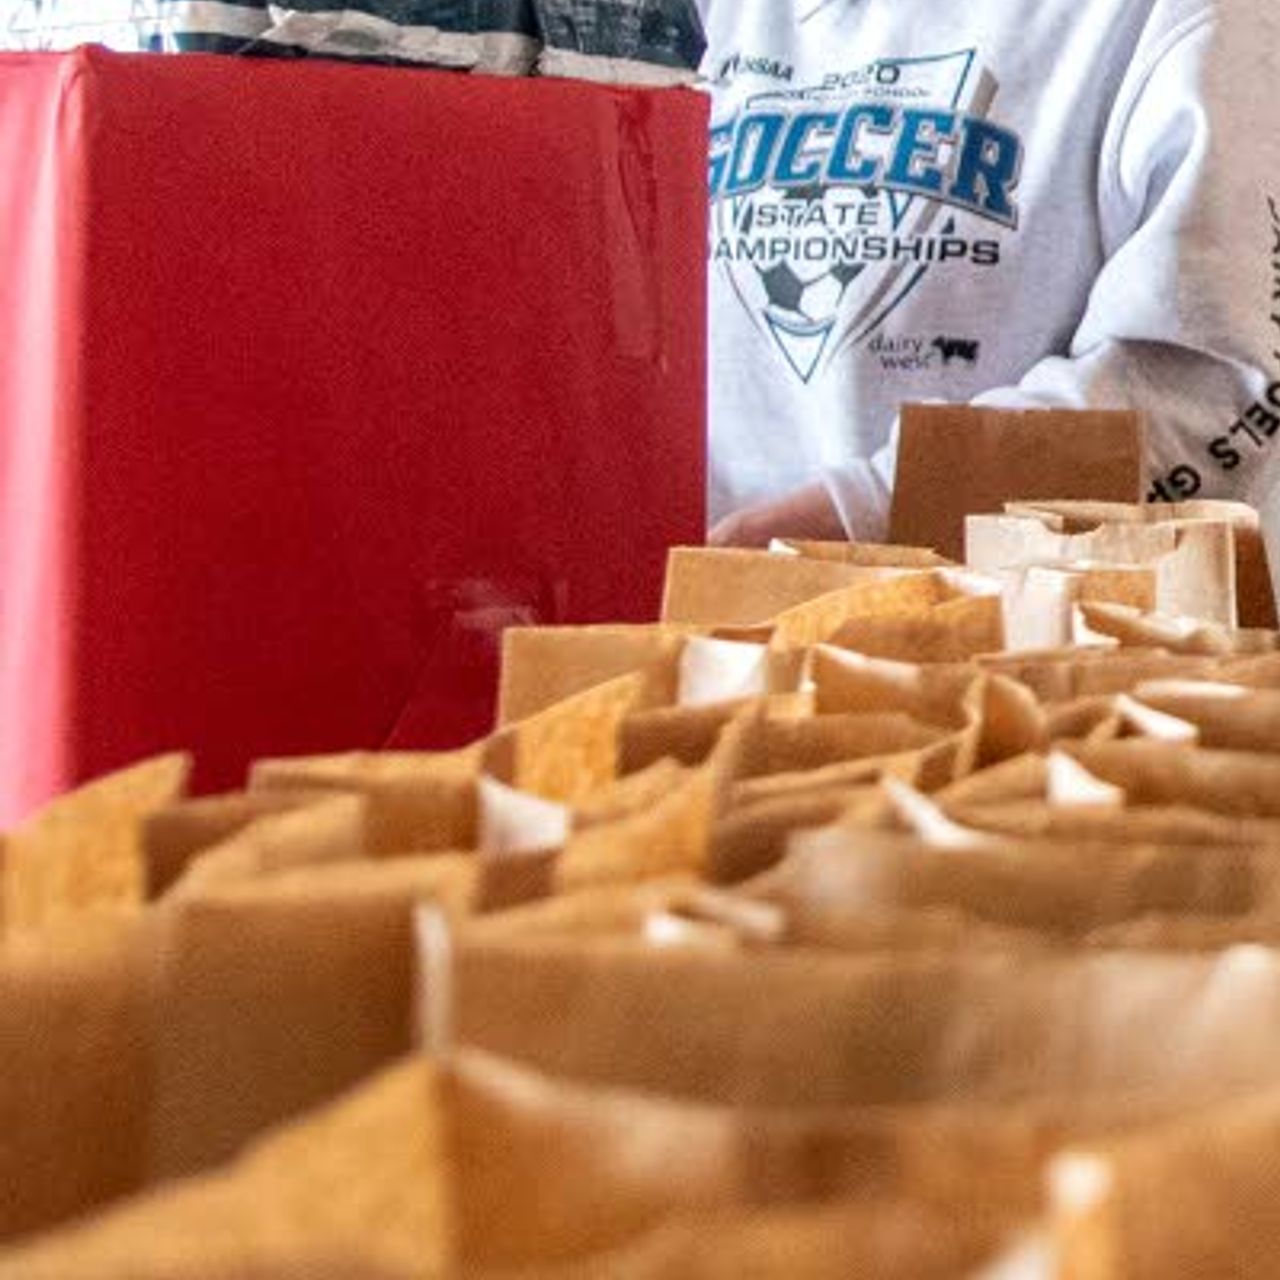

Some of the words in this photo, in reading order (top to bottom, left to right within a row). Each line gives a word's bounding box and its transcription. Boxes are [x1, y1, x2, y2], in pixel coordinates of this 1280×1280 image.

[756, 200, 882, 228] STATE
[714, 235, 1000, 266] AMPIONSHIPS
[867, 333, 923, 353] dairy
